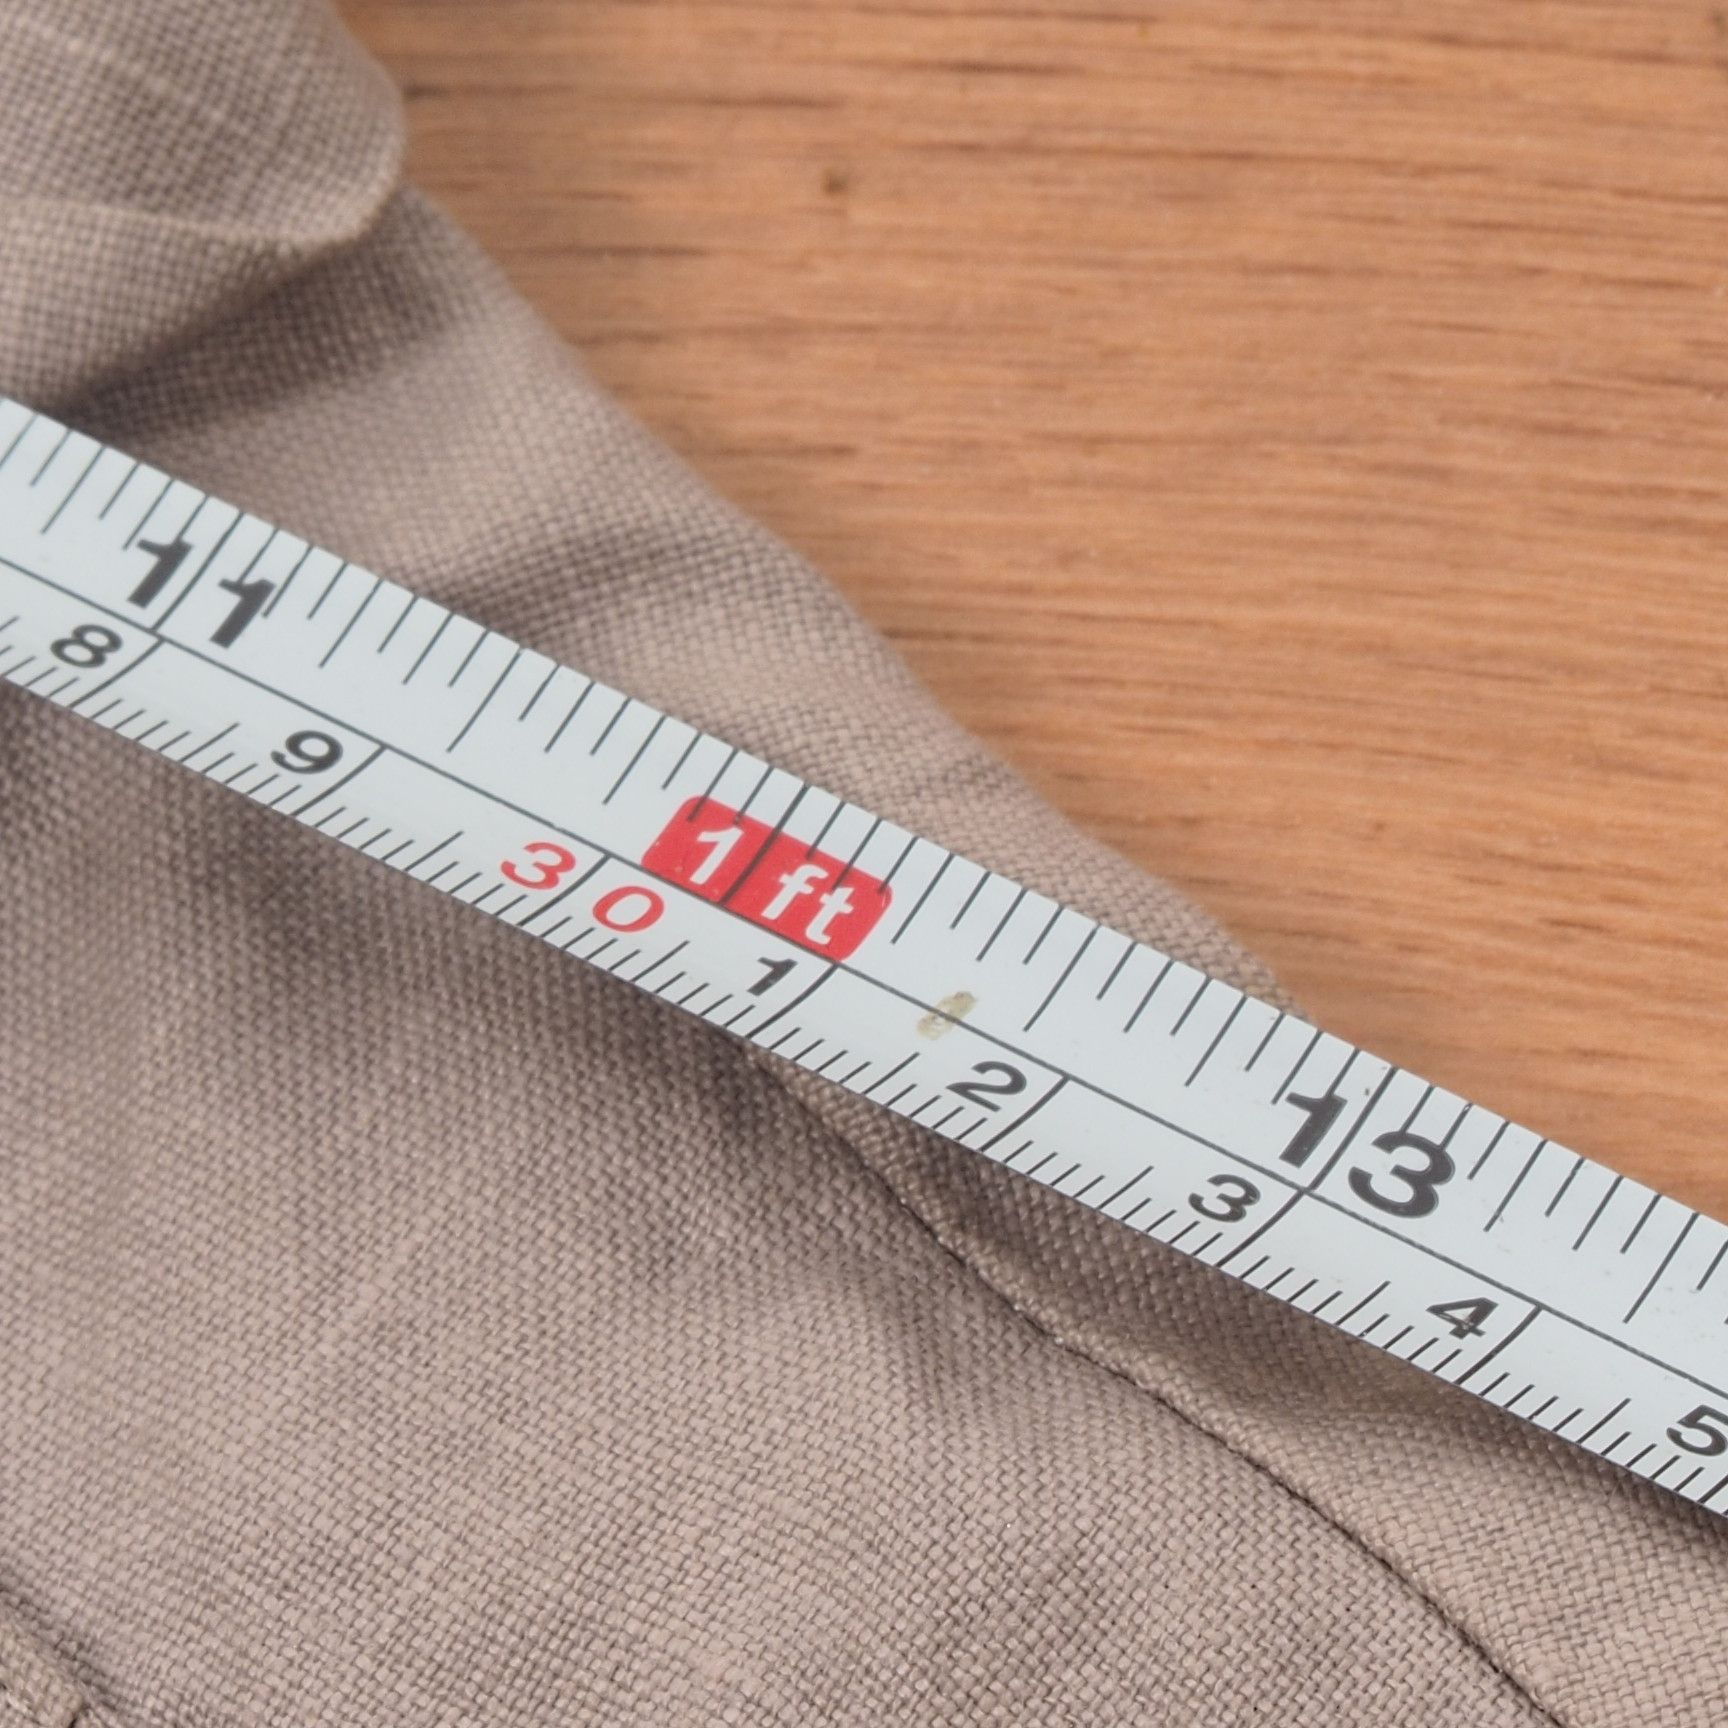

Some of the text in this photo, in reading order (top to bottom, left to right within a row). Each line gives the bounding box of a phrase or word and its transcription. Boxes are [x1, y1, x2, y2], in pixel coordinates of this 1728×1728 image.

[127, 534, 275, 648] 11
[50, 623, 123, 669] 8
[270, 730, 343, 775] 9
[500, 841, 665, 934] 30
[747, 956, 798, 996] 1
[947, 1060, 1027, 1111] 2
[1278, 1090, 1456, 1218] 13
[1188, 1173, 1261, 1223] 3
[1425, 1296, 1498, 1339] 4
